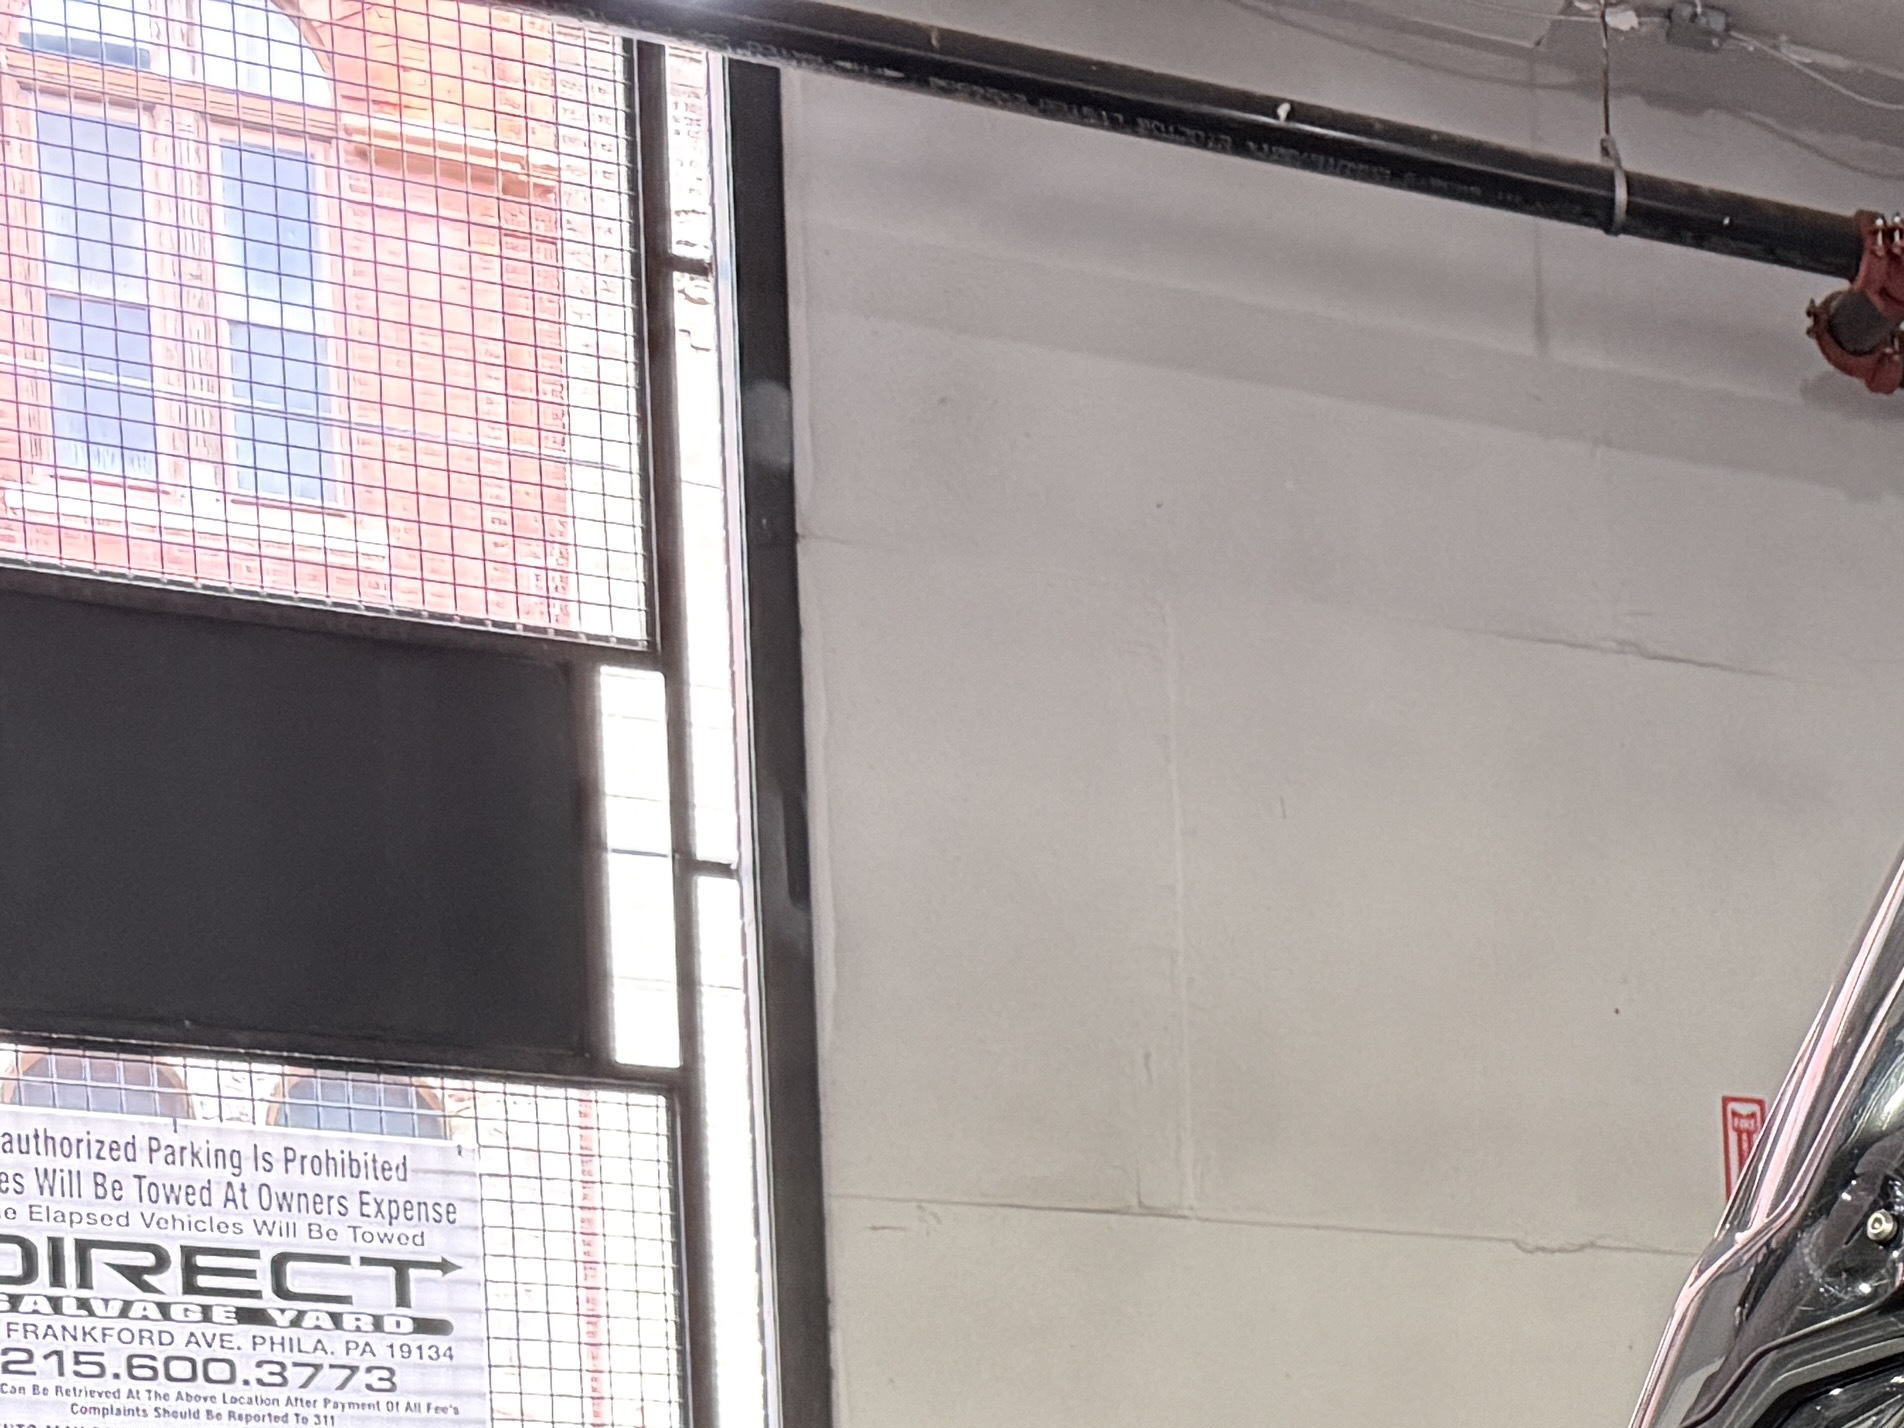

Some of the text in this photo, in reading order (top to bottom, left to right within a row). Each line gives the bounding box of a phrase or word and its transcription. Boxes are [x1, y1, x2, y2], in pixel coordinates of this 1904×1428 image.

[1, 1127, 408, 1182] authorized Parking Is Prohibited
[34, 1167, 82, 1199] Will
[93, 1172, 123, 1202] Be
[133, 1174, 212, 1207] Towed
[223, 1181, 249, 1210] At
[258, 1183, 349, 1218] Owners
[359, 1190, 458, 1226] Expense
[28, 1204, 130, 1228] Elapsed
[141, 1211, 244, 1235] Vehicles
[253, 1218, 297, 1239] Will
[308, 1223, 338, 1241] Be
[347, 1225, 425, 1246] Towed
[6, 1321, 454, 1361] FRANKFORD AVE. PHILA. PA 19134
[267, 1308, 414, 1334] YARD
[1, 1347, 397, 1392] 215.600.3773
[0, 1383, 26, 1395] Can
[32, 1384, 49, 1396] Be
[55, 1385, 120, 1399] Retrieved
[126, 1388, 141, 1399] At
[147, 1389, 170, 1402] The
[175, 1391, 217, 1404] Above
[222, 1392, 280, 1407] Location
[285, 1395, 317, 1408] After
[323, 1398, 381, 1413] Payment
[387, 1401, 399, 1413] Of
[405, 1401, 421, 1413] All
[70, 1402, 335, 1426] Complaints Should Be Reported To 311
